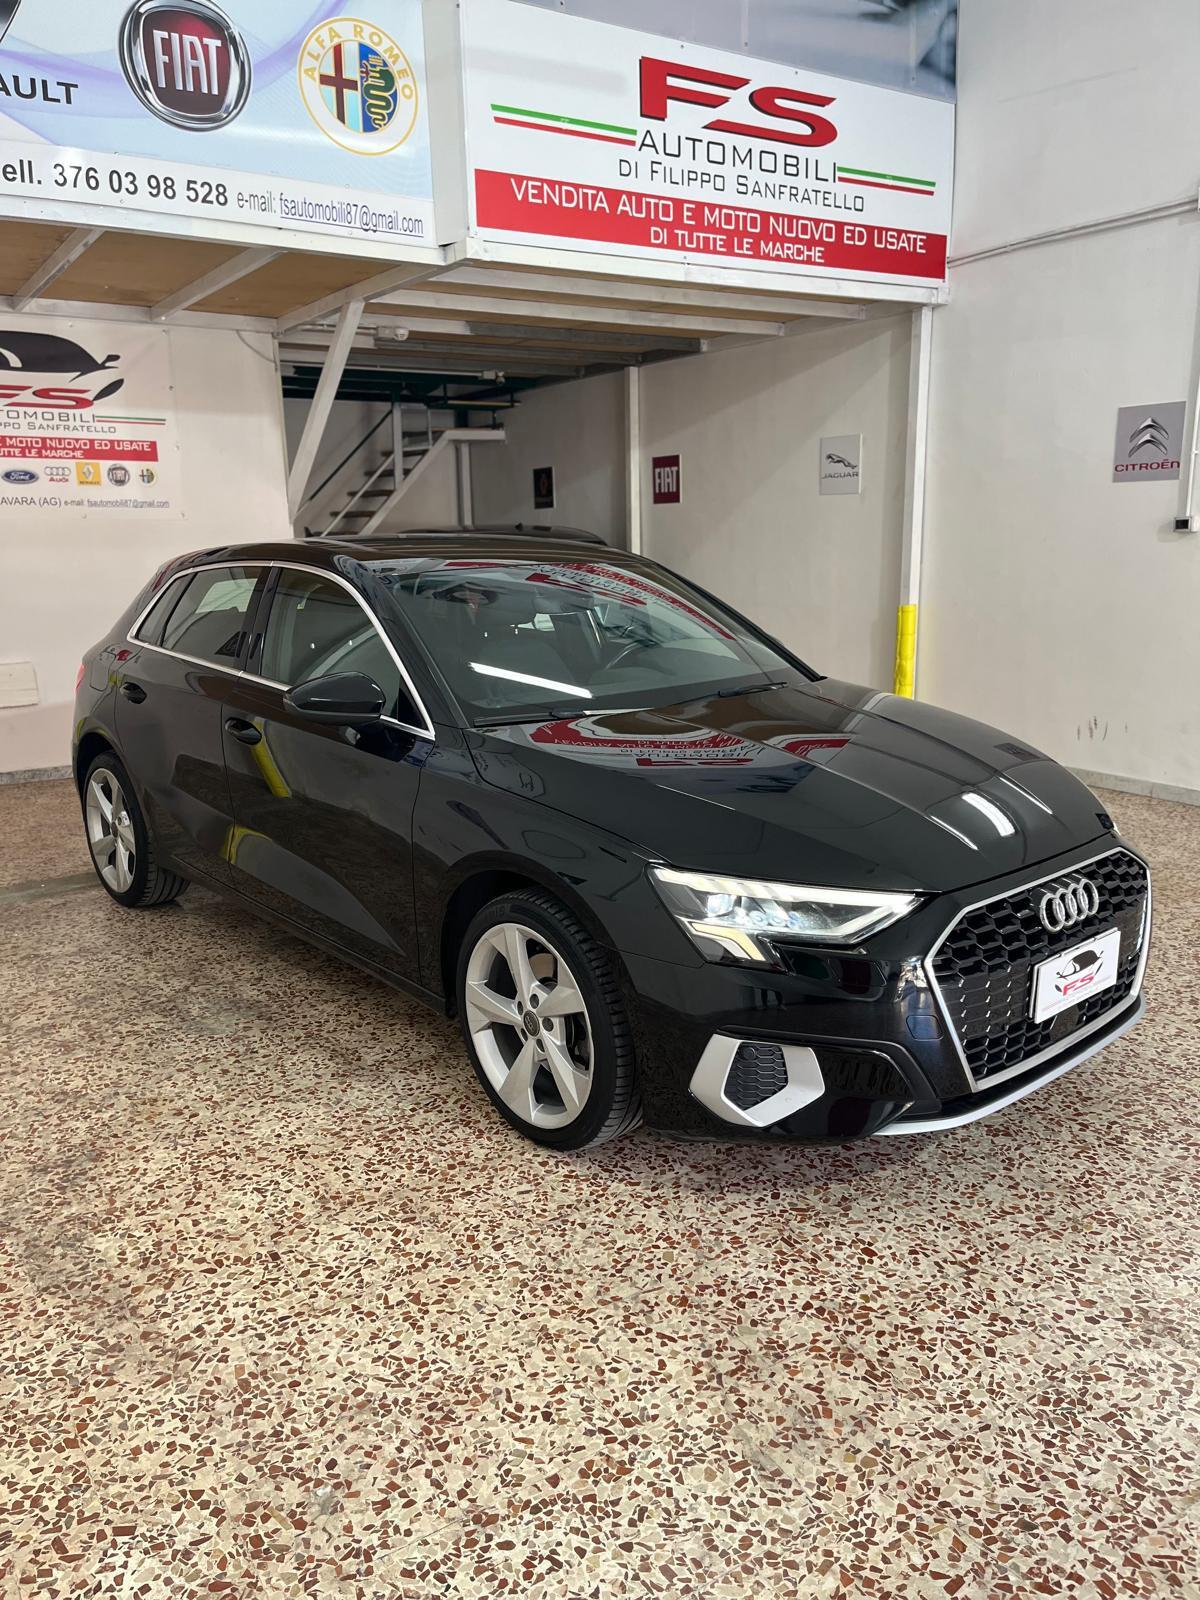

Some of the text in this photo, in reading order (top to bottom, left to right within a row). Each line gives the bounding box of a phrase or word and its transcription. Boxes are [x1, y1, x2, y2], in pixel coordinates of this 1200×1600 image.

[153, 29, 222, 96] FIAT
[303, 24, 414, 100] ALFA ROMEO
[639, 56, 838, 148] FS
[639, 129, 836, 183] AUTOMOBILI
[53, 163, 100, 191] 376
[109, 169, 138, 195] 03
[147, 174, 176, 200] 98
[186, 179, 228, 206] 528
[237, 191, 277, 214] e-mail:
[279, 192, 424, 235] fsautomobili87@gmail.com
[619, 159, 864, 212] DI FILIPPO SANFRATELLO
[510, 178, 927, 253] VENDITA AUTO E MOTO NUOVO ED USATE
[651, 226, 825, 263] DI TUTTE LE MARCHE
[6, 437, 151, 451] MOTO NUOVO ED USATE
[27, 422, 117, 433] SANFRATELLO
[25, 448, 39, 457] LE
[42, 449, 84, 458] MARCHE
[655, 466, 678, 493] FIAT
[821, 471, 859, 479] JAGUAR
[39, 496, 61, 508] (AG)
[1063, 971, 1094, 997] FS
